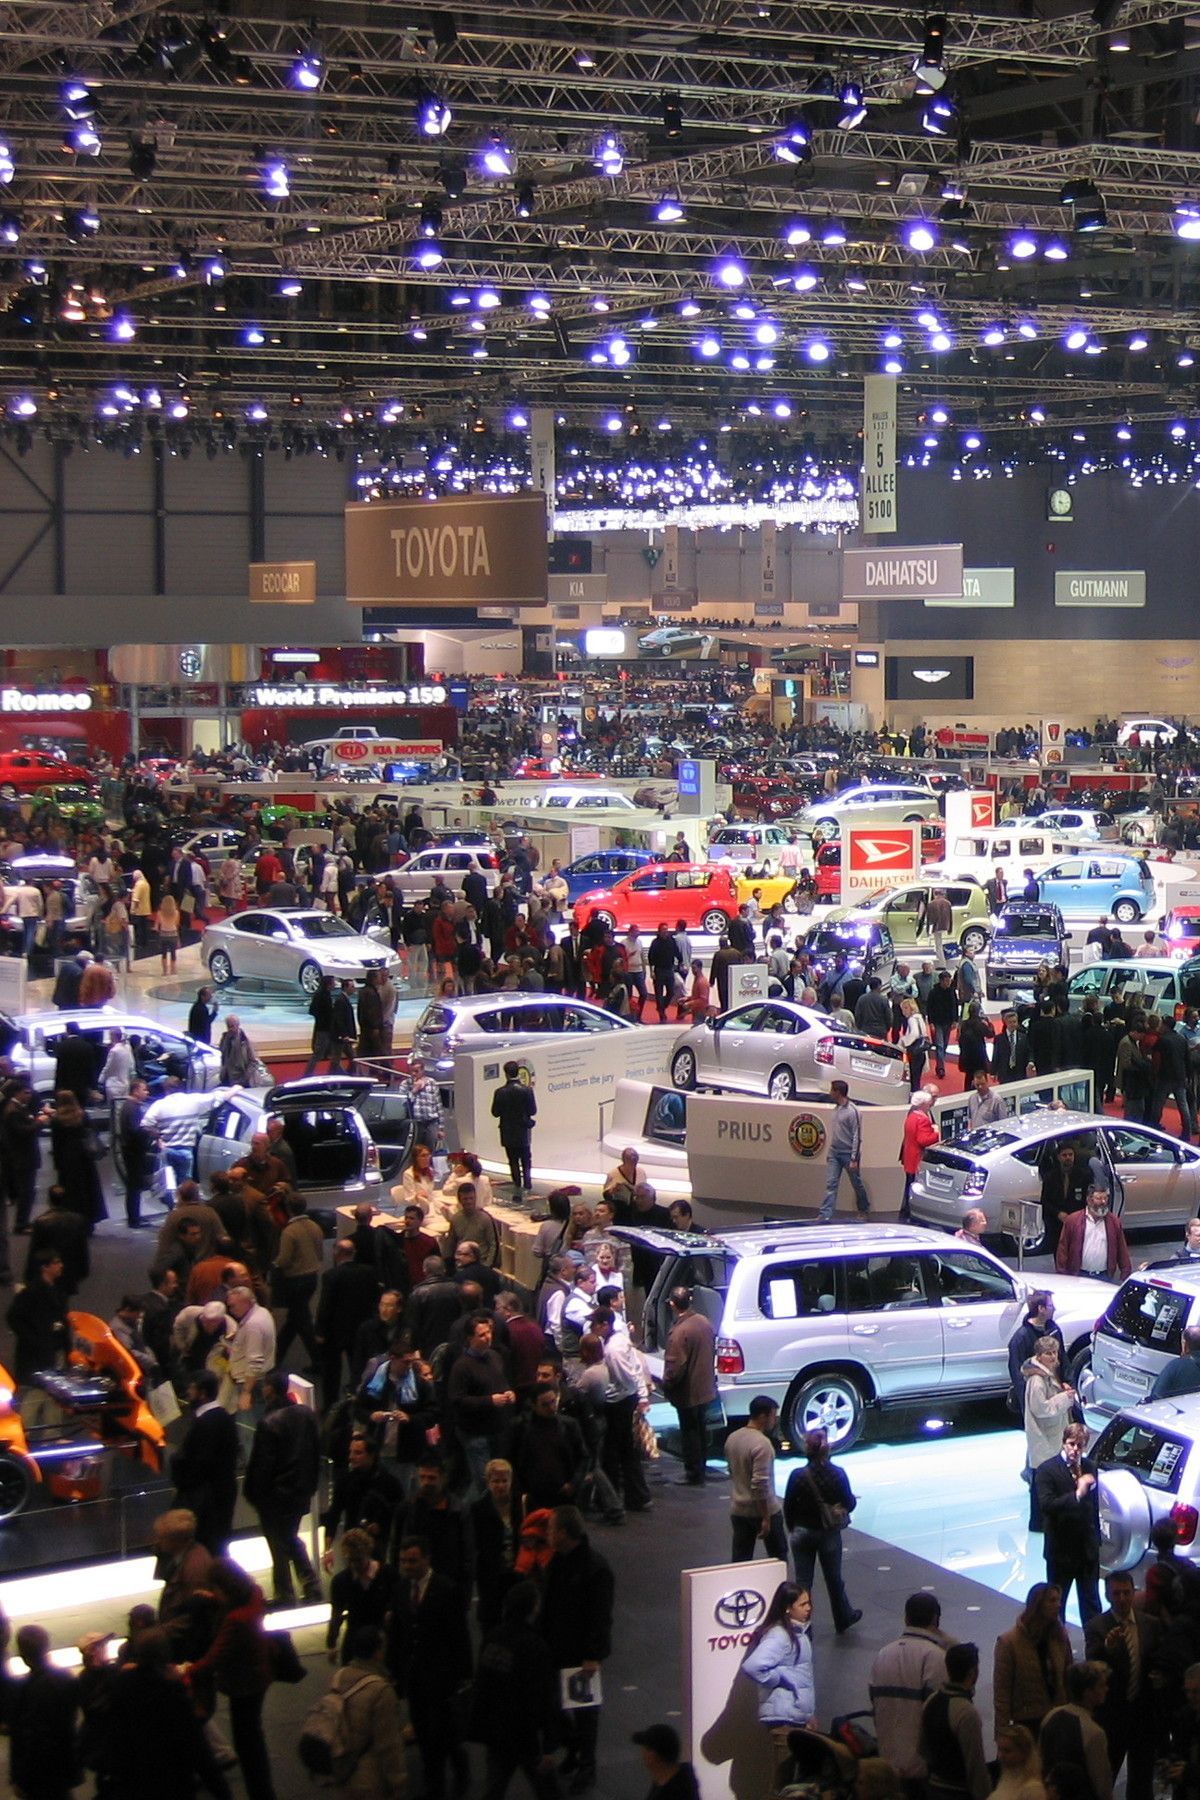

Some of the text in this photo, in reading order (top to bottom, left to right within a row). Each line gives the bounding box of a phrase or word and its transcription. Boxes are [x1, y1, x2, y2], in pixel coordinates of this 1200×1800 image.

[877, 443, 884, 468] 5
[865, 474, 895, 494] ALLEE
[868, 500, 892, 519] 5100
[390, 525, 491, 578] TOYOTA
[865, 559, 938, 586] DAIHATSU
[262, 573, 300, 593] ECOCAR
[569, 582, 585, 597] KIA
[1069, 579, 1129, 598] GUTMANN
[1, 689, 92, 711] Romeo
[256, 686, 446, 706] World Premiere 159
[339, 744, 441, 756] KIA KIA MOTORS
[519, 797, 530, 806] to
[547, 1074, 615, 1093] Quotes from the jury
[717, 1119, 773, 1142] PRIUS
[708, 1631, 752, 1651] TOYO
